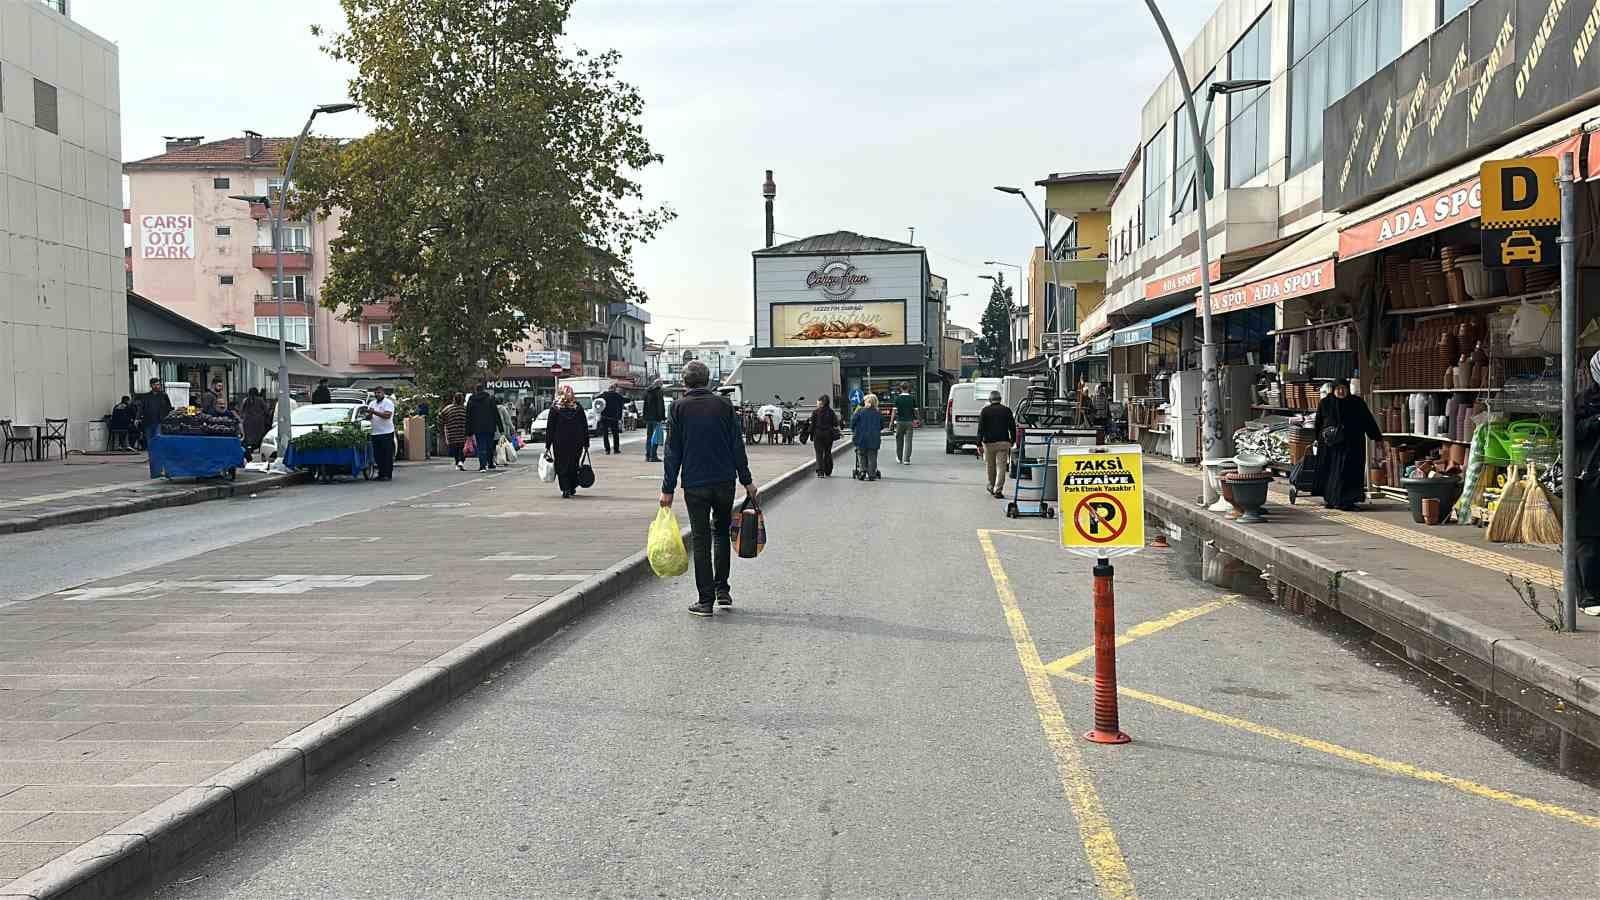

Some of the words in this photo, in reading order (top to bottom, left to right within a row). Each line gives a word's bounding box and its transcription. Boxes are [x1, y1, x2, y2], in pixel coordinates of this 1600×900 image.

[1500, 166, 1538, 211] D
[1377, 206, 1427, 242] ADA
[1435, 182, 1481, 221] SPO
[149, 232, 185, 245] OTO
[145, 247, 190, 257] PARK
[1162, 278, 1176, 292] ADA
[1178, 273, 1195, 288] SPOT
[1253, 284, 1280, 301] ADA
[1283, 269, 1322, 293] SPOT
[1074, 456, 1123, 471] TAKSİ
[1069, 475, 1129, 485] İTFAİYE
